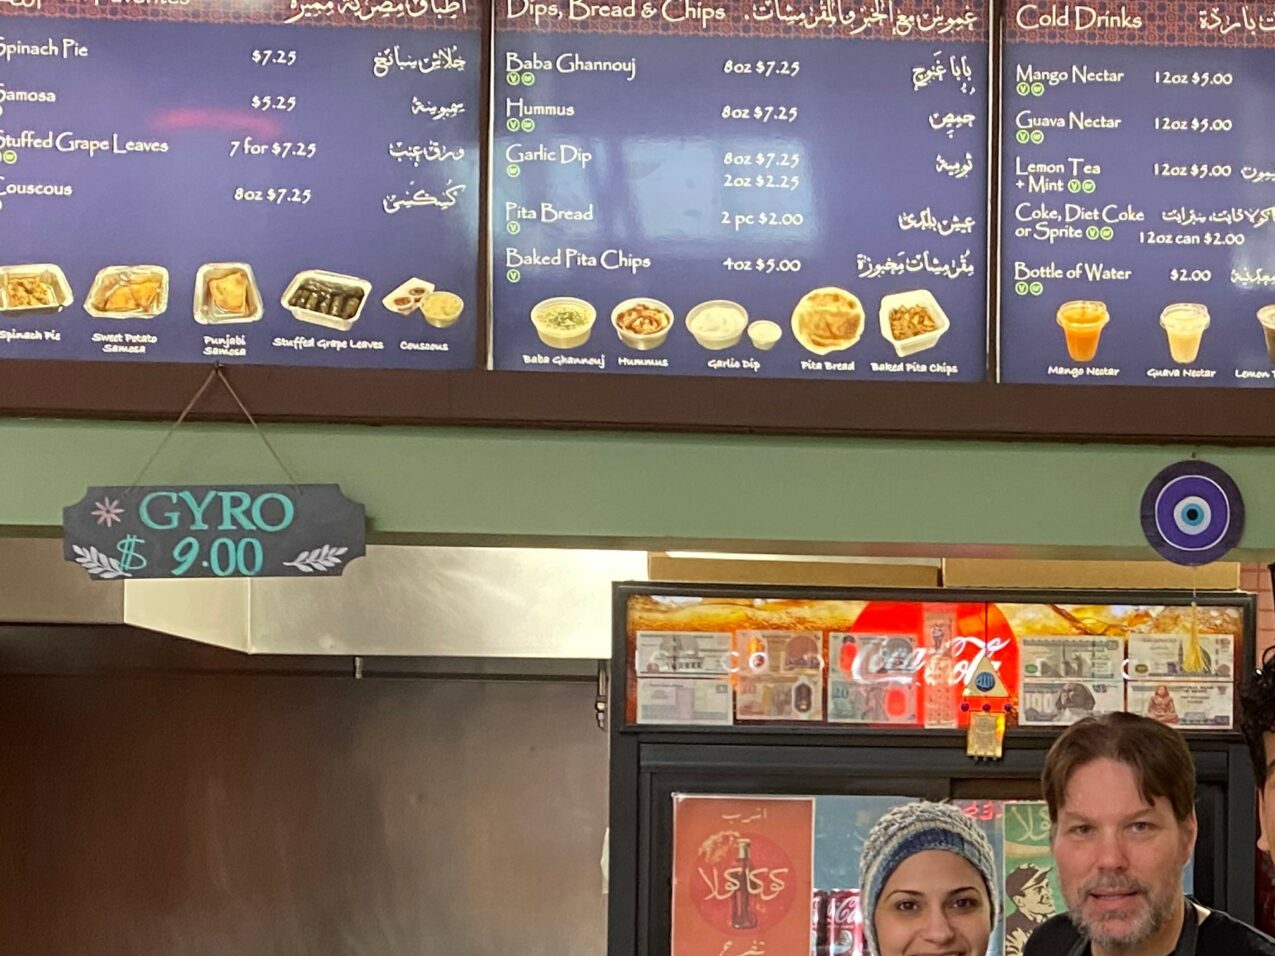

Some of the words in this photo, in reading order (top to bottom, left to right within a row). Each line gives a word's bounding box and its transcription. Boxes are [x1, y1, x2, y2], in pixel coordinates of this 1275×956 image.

[507, 0, 563, 26] Dips,
[568, 0, 636, 21] Bread
[641, 3, 657, 17] &
[662, 0, 726, 29] Chips
[1016, 4, 1069, 30] Cold
[1075, 6, 1143, 31] Drinks
[0, 37, 58, 61] Spinach
[63, 38, 88, 58] Pie
[252, 50, 296, 66] $7.25
[506, 52, 552, 72] Baba
[556, 53, 636, 81] Ghannouj
[724, 60, 752, 74] 8oz
[755, 60, 800, 77] $7.25
[1016, 64, 1068, 86] Mango
[1072, 65, 1124, 83] Nectar
[1155, 71, 1188, 84] 12oz
[1192, 72, 1233, 87] $5.00
[252, 96, 296, 112] $5.25
[506, 97, 575, 117] Hummus
[1016, 110, 1065, 129] Guava
[1069, 111, 1122, 130] Nectar
[56, 131, 109, 157] Grape
[113, 133, 168, 153] Leaves
[230, 141, 240, 157] 7
[244, 137, 268, 153] for
[272, 143, 316, 158] $7.25
[505, 144, 556, 163] Garlic
[560, 144, 592, 169] Dip
[1016, 156, 1065, 176] Lemon
[1068, 157, 1101, 176] Tea
[724, 175, 752, 188] 2oz
[755, 175, 799, 191] $2.25
[1016, 180, 1025, 189] +
[1028, 175, 1064, 193] Mint
[506, 202, 536, 222] Pita
[541, 202, 594, 223] Bread
[1015, 203, 1062, 222] Coke,
[1065, 204, 1099, 222] Diet
[1102, 204, 1145, 224] Coke
[1015, 228, 1031, 238] or
[1033, 222, 1083, 244] Sprite
[506, 248, 561, 267] Baked
[566, 250, 597, 268] Pita
[600, 250, 651, 274] Chips
[1014, 261, 1063, 280] Bottle
[1066, 263, 1083, 279] of
[1084, 264, 1132, 281] Water
[618, 357, 669, 367] Hummus
[139, 490, 294, 532] GYRO
[171, 537, 263, 576] 9.00
